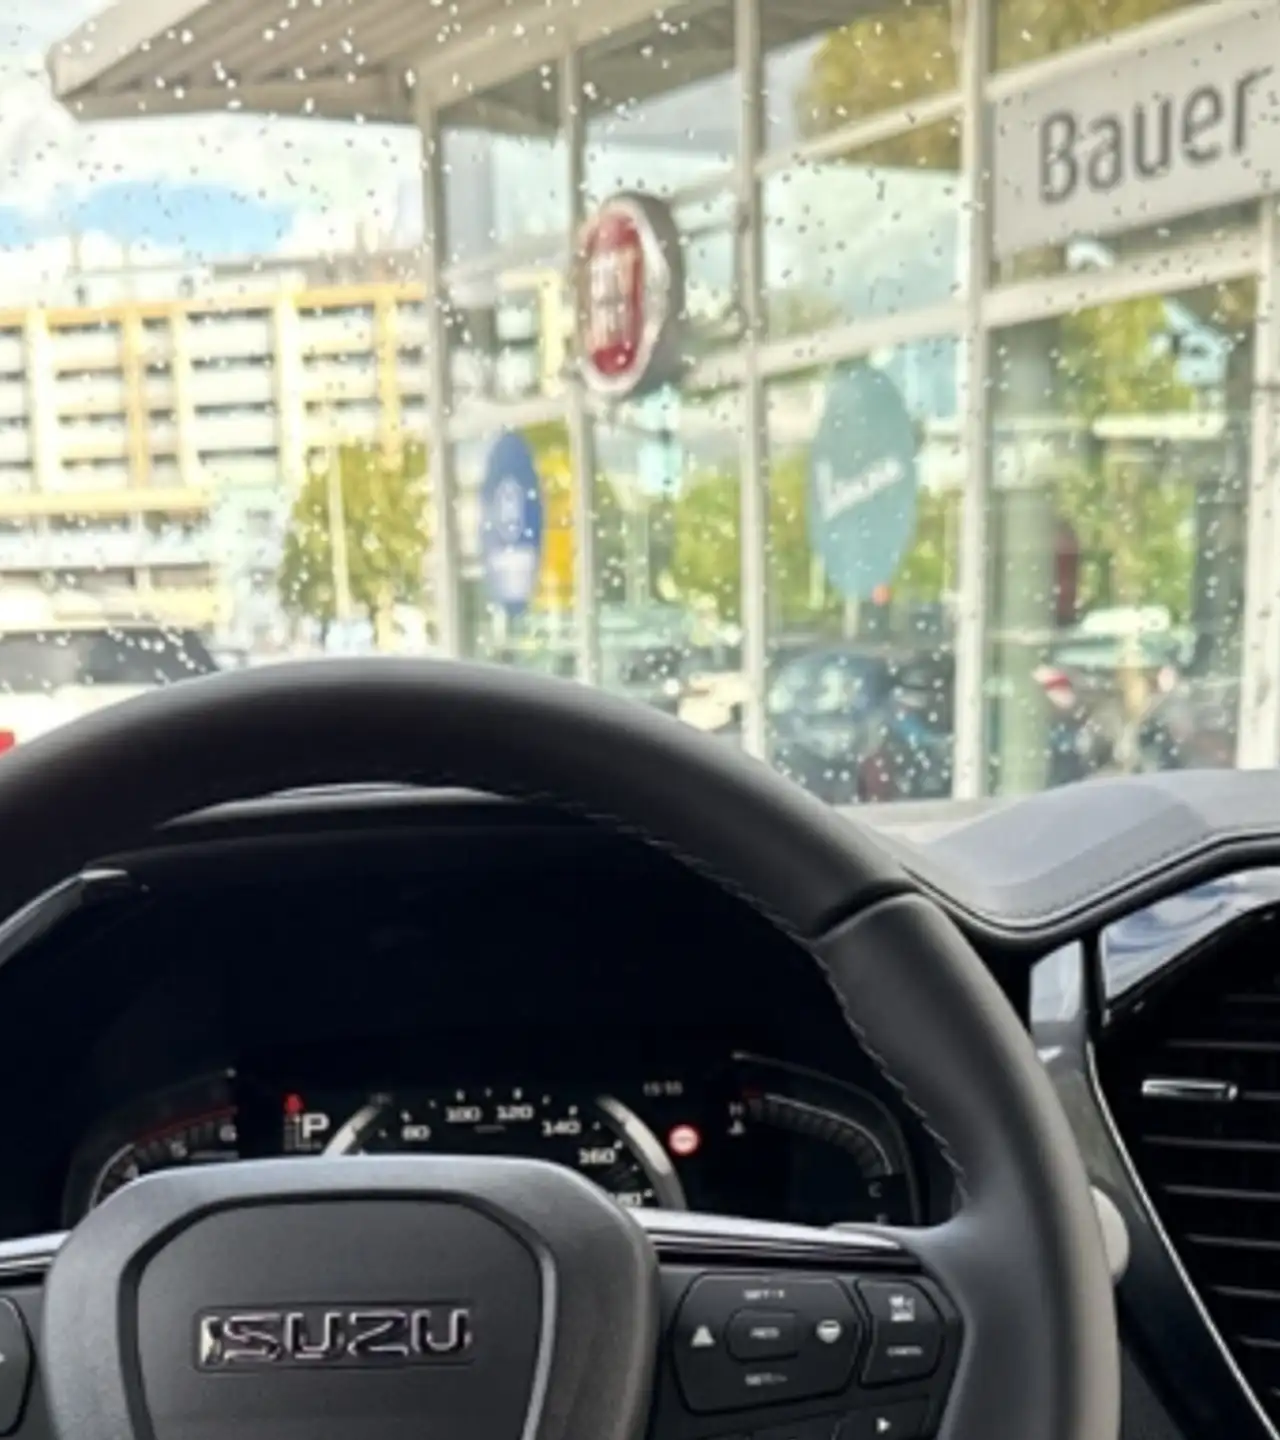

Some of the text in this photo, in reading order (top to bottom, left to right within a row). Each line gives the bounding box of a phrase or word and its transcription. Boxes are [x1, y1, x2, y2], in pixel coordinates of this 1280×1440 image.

[1039, 64, 1273, 205] Bauer
[302, 1112, 330, 1140] P
[496, 1104, 535, 1121] 120
[200, 1309, 472, 1365] ISUZU
